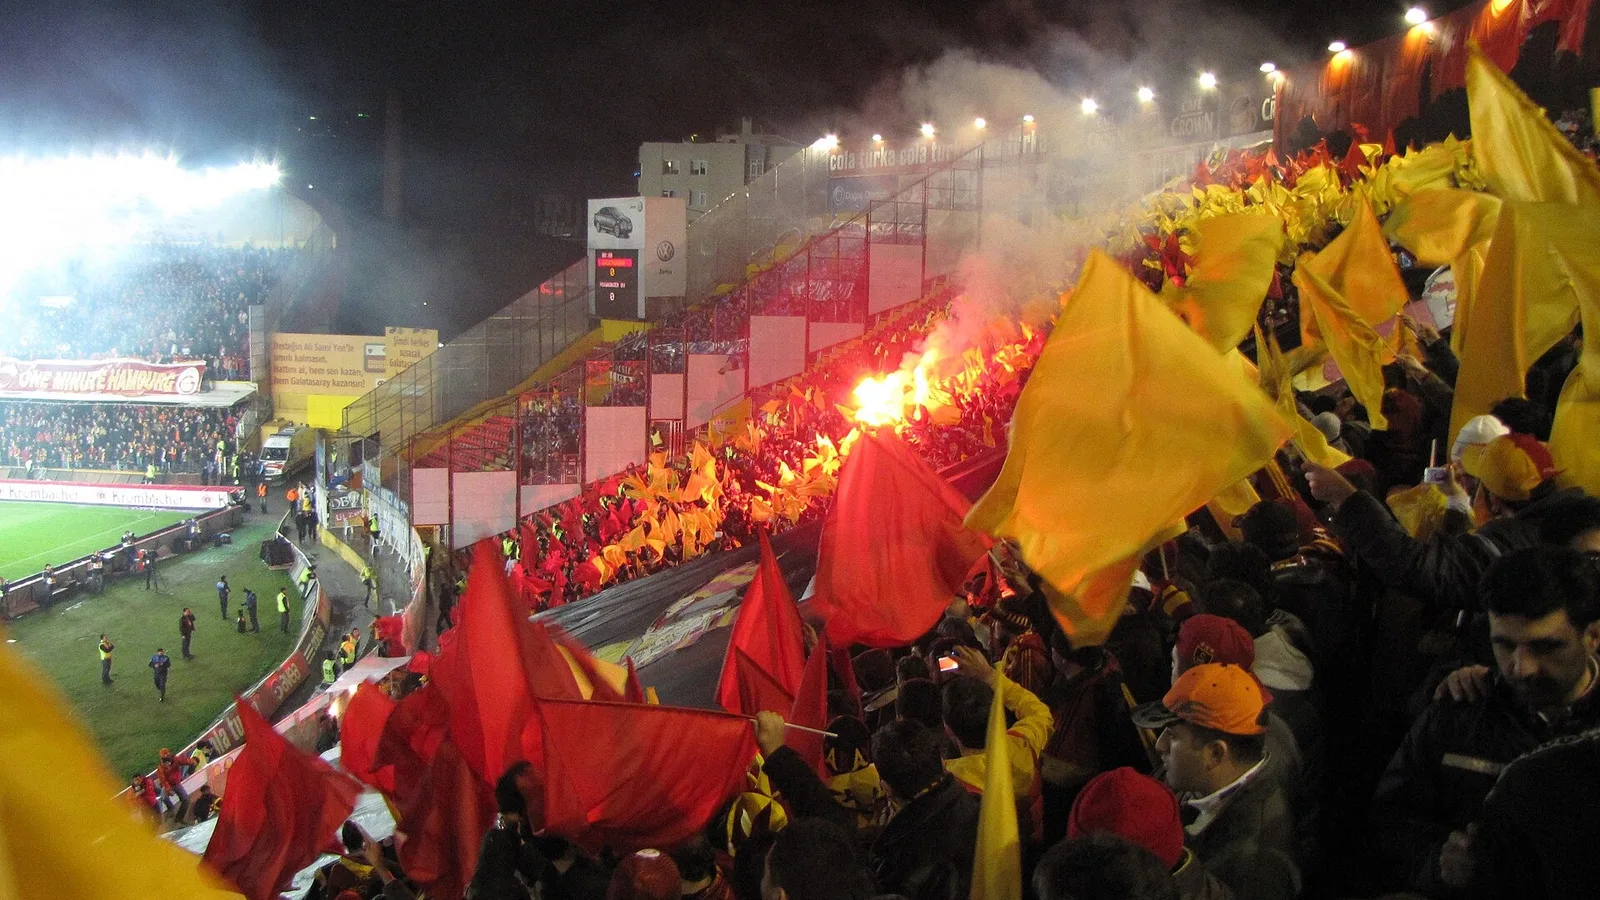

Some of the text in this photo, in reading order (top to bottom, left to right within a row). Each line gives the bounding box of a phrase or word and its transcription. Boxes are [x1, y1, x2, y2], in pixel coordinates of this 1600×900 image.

[1171, 112, 1214, 137] CROWN
[829, 150, 856, 171] cola
[860, 146, 896, 169] turka
[900, 144, 927, 166] cola
[304, 342, 314, 351] Ali
[314, 343, 332, 352] Sami
[19, 369, 52, 389] ONE
[52, 368, 106, 392] MINUTE
[106, 366, 177, 393] HAMBURG
[309, 367, 325, 375] hem
[340, 367, 364, 377] kazan,
[273, 377, 289, 385] hem
[290, 376, 331, 388] Galatasaray
[9, 486, 183, 505] Krombacher Krombacher
